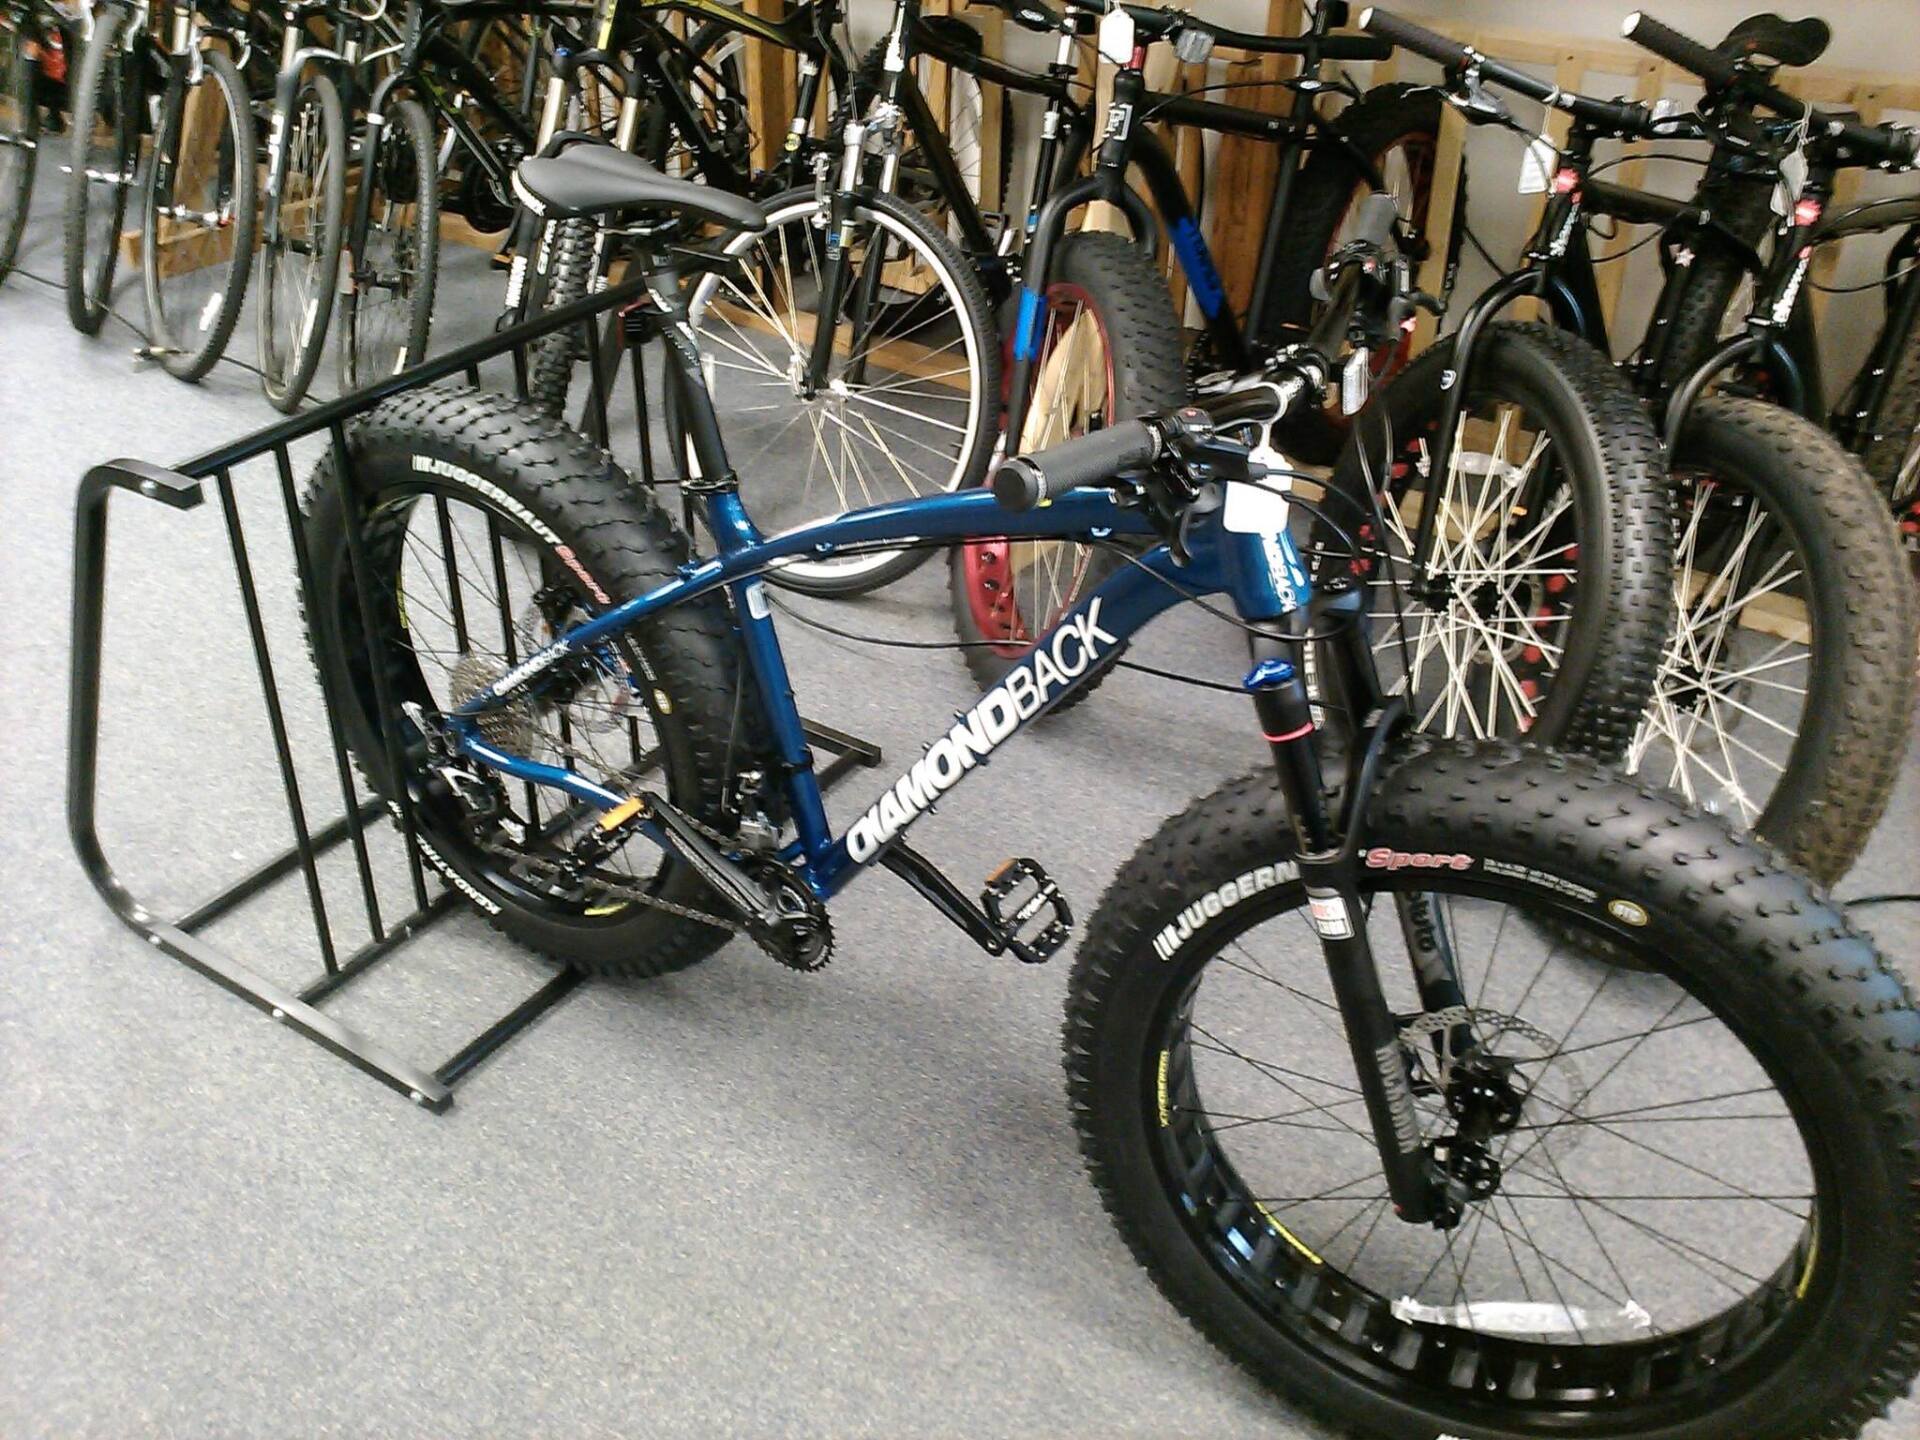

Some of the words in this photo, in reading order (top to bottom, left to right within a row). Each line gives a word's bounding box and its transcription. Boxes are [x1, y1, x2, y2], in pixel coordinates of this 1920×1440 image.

[846, 596, 1119, 864] DIAMONDBACK
[1176, 859, 1301, 941] JUGGERN
[1365, 847, 1476, 871] Sport
